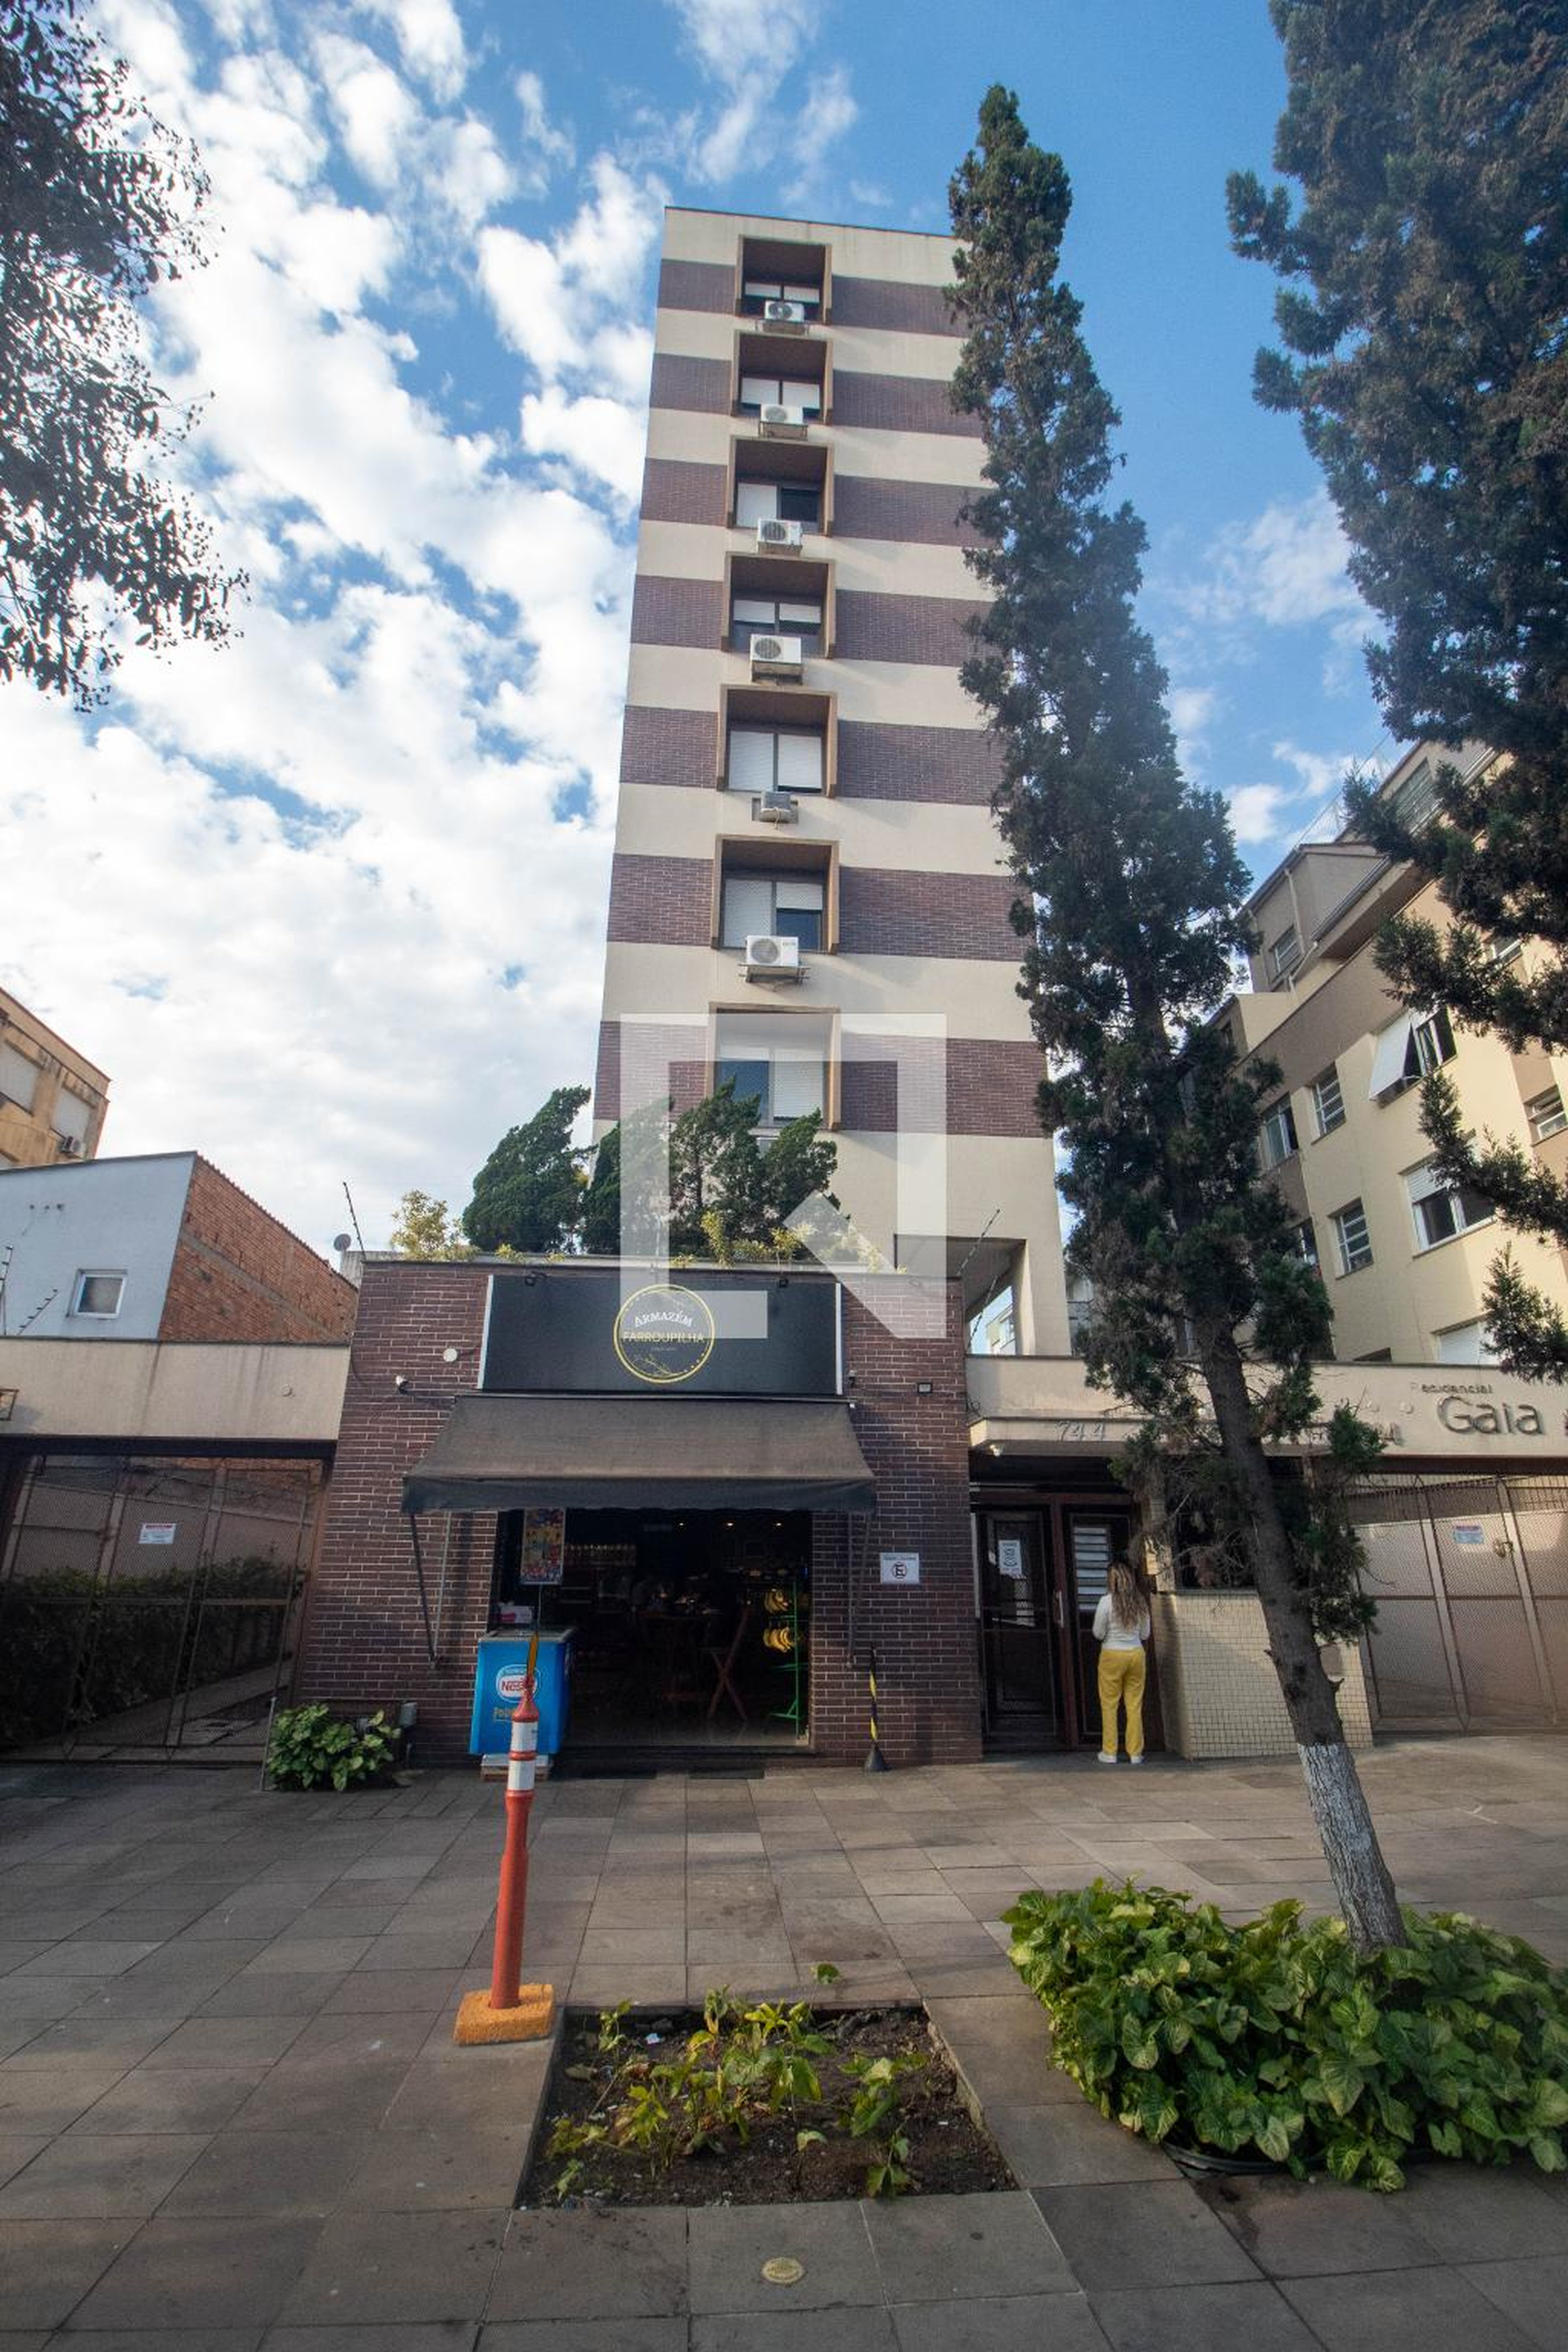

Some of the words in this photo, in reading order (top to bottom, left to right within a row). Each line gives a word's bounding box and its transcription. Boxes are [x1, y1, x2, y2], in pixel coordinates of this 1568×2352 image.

[635, 1310, 693, 1327] ARMAZÉM
[623, 1331, 705, 1343] FARROUPILHA
[1438, 1396, 1542, 1435] Gaia
